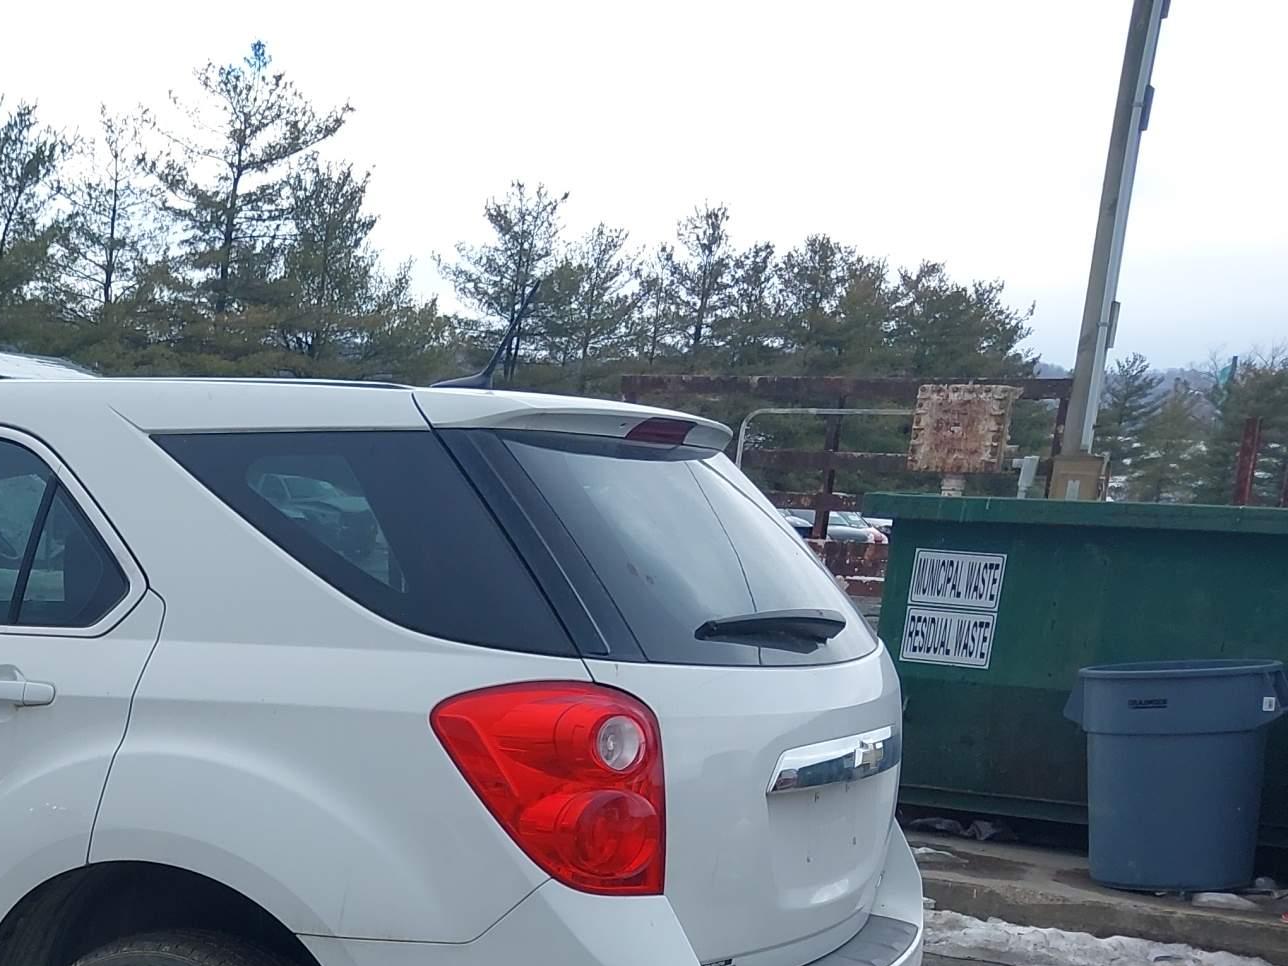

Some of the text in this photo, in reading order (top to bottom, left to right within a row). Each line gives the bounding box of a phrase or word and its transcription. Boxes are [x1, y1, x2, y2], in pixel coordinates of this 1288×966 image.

[914, 557, 1001, 601] MUNICIPAL WASTE
[905, 615, 991, 659] RESIDUAL WASTE
